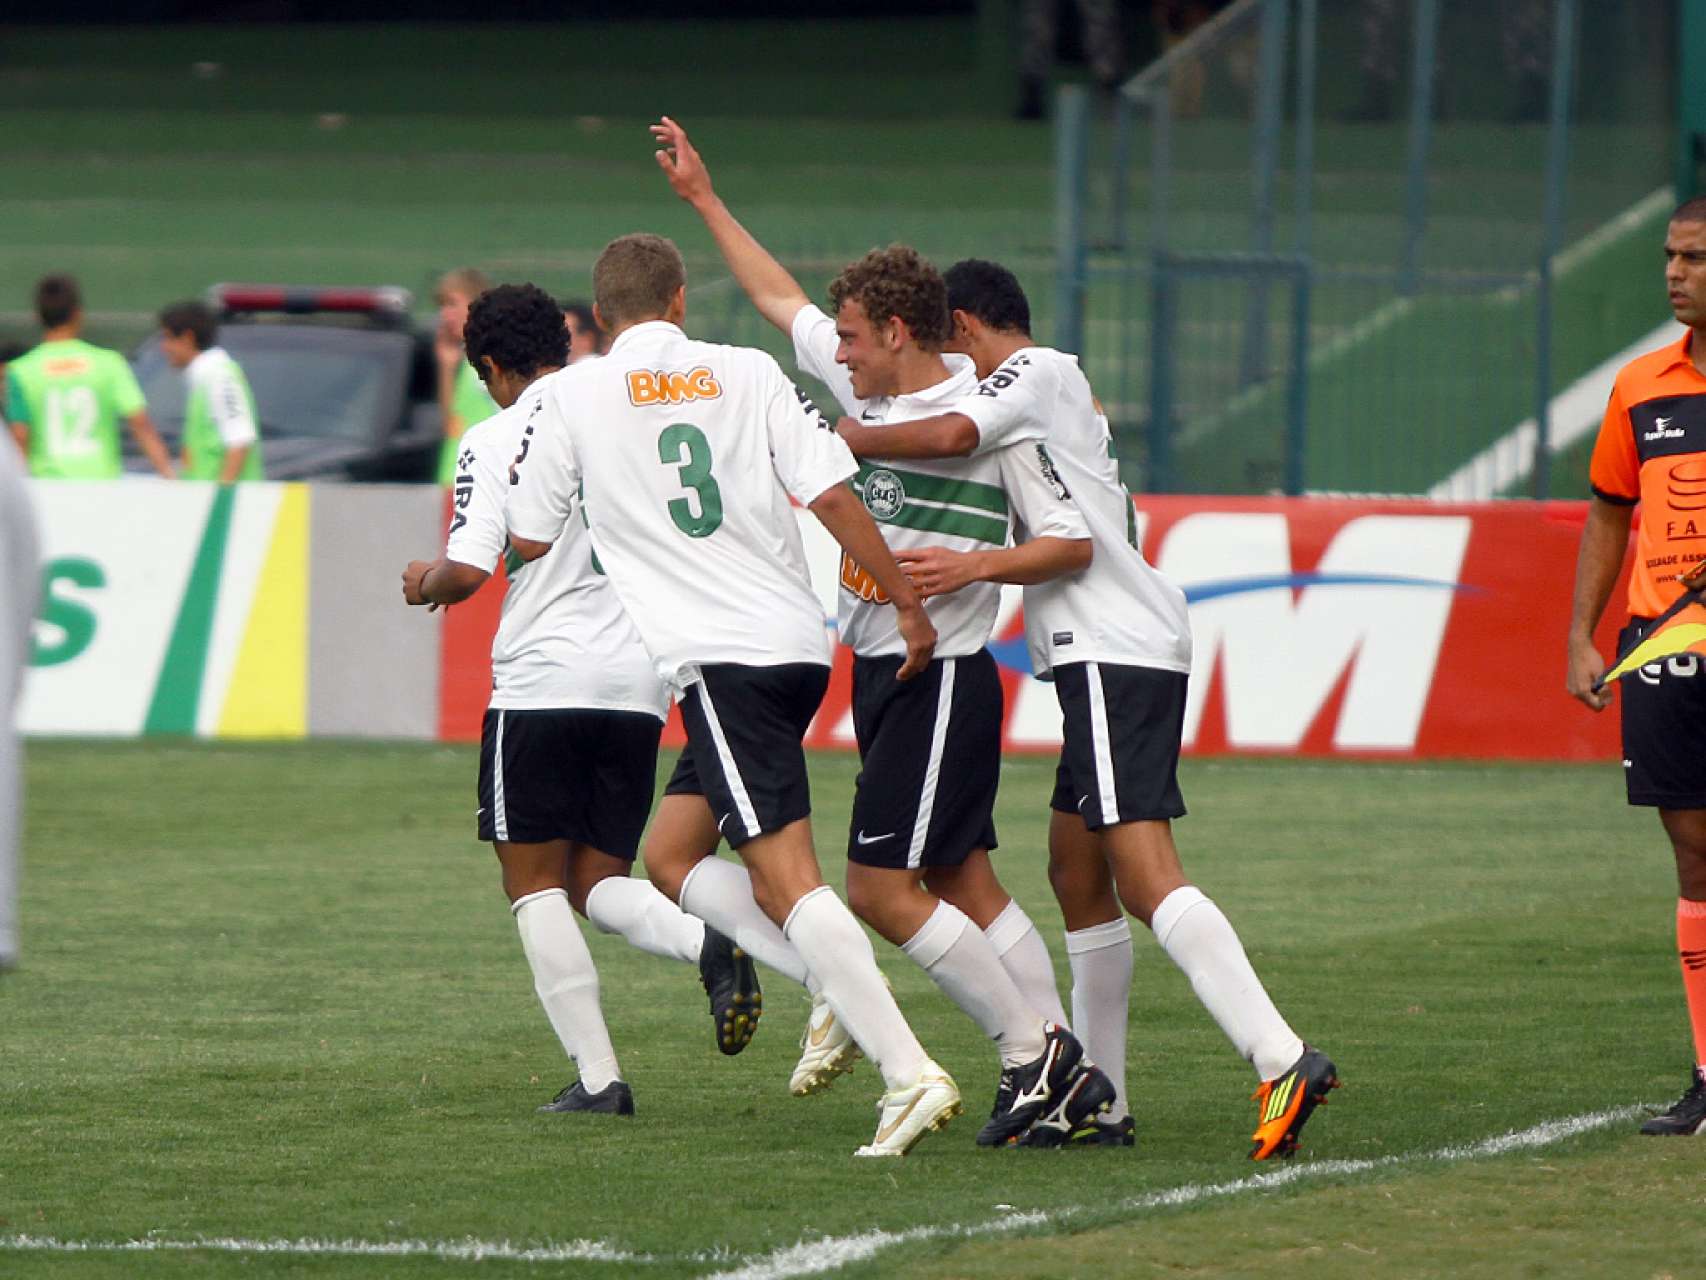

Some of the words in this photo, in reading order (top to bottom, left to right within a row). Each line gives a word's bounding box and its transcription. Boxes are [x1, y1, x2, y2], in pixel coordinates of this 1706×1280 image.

[45, 386, 100, 454] 12
[626, 367, 722, 405] BMG
[658, 423, 723, 538] 3
